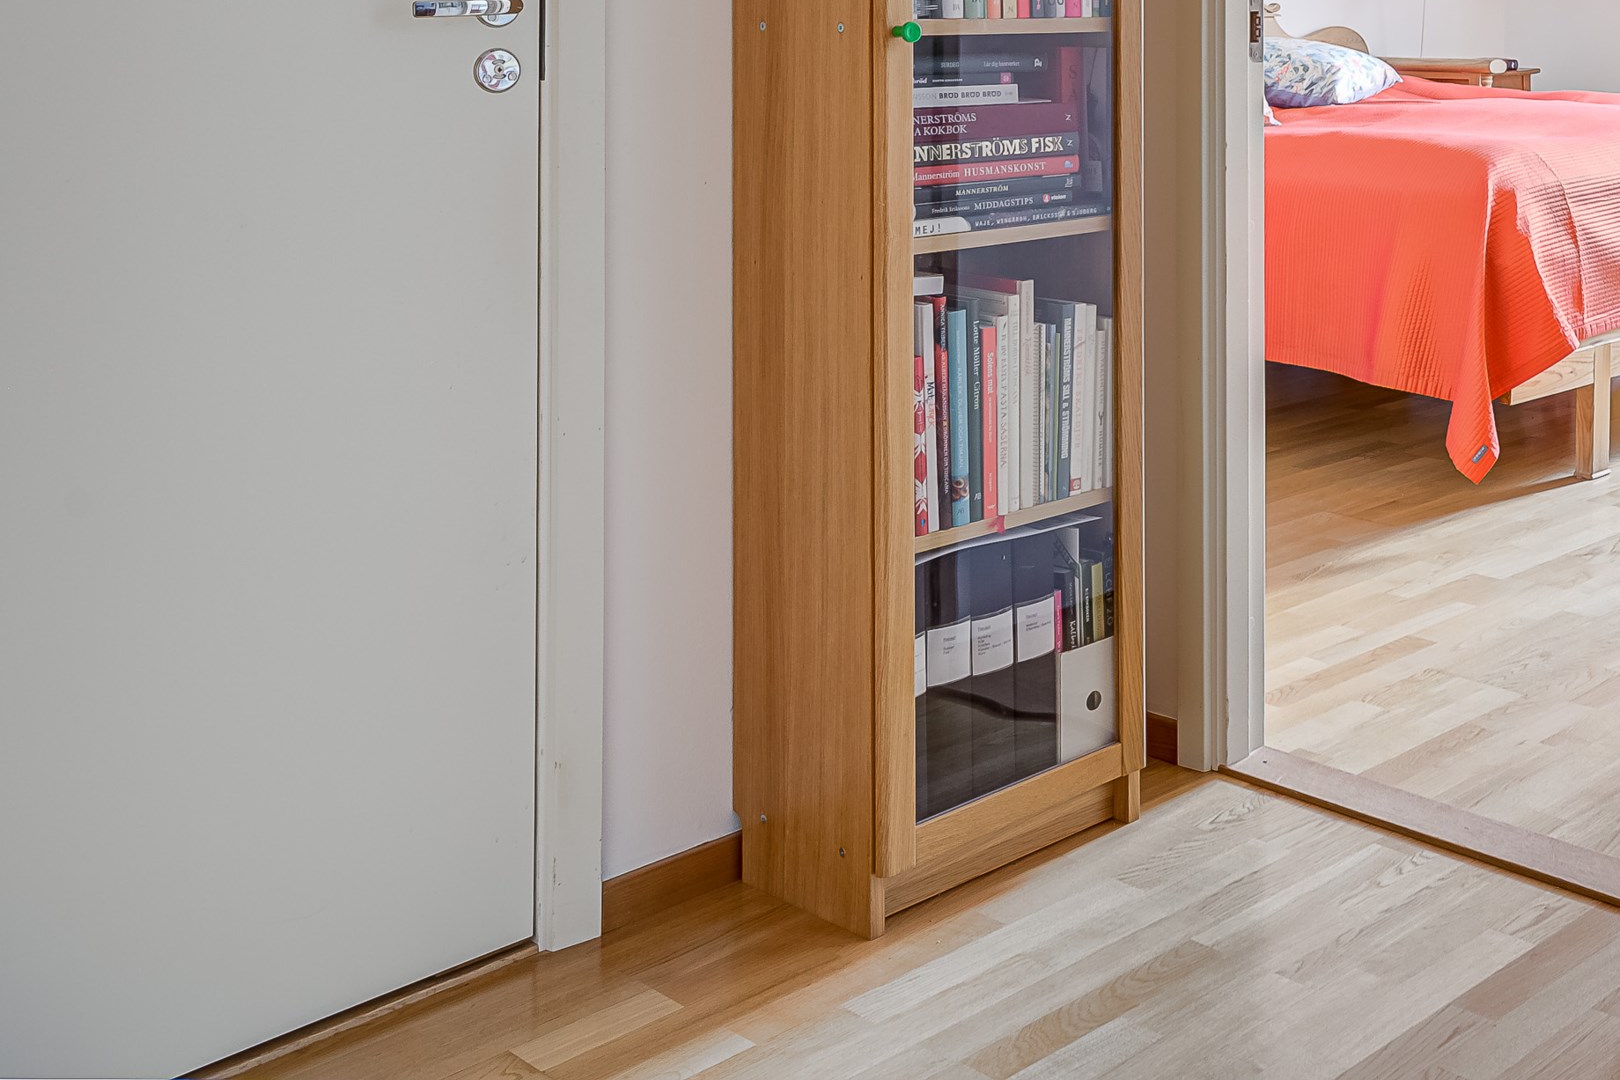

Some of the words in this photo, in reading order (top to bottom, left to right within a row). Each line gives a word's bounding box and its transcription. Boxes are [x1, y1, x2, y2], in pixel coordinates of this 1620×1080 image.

[939, 91, 959, 100] BRÖD
[961, 90, 981, 99] BRÖD
[982, 89, 1002, 99] BRÖD
[923, 124, 969, 137] KOKBOK
[1031, 136, 1065, 153] FISK
[963, 161, 1047, 177] HUSMANSKONST
[956, 185, 1009, 197] MANNERSTRÖM
[931, 206, 949, 215] Fredrik
[974, 197, 1034, 211] MIDDAGSTIPS
[1051, 194, 1067, 202] vision
[915, 222, 942, 236] MEJ!
[1063, 318, 1073, 383] MANNERSTRÖMS
[973, 347, 981, 376] Möller
[986, 351, 994, 378] Solens
[973, 380, 981, 410] Citron
[986, 379, 994, 395] mat
[1062, 384, 1071, 400] SILL
[1061, 410, 1071, 459] STRÖMMING
